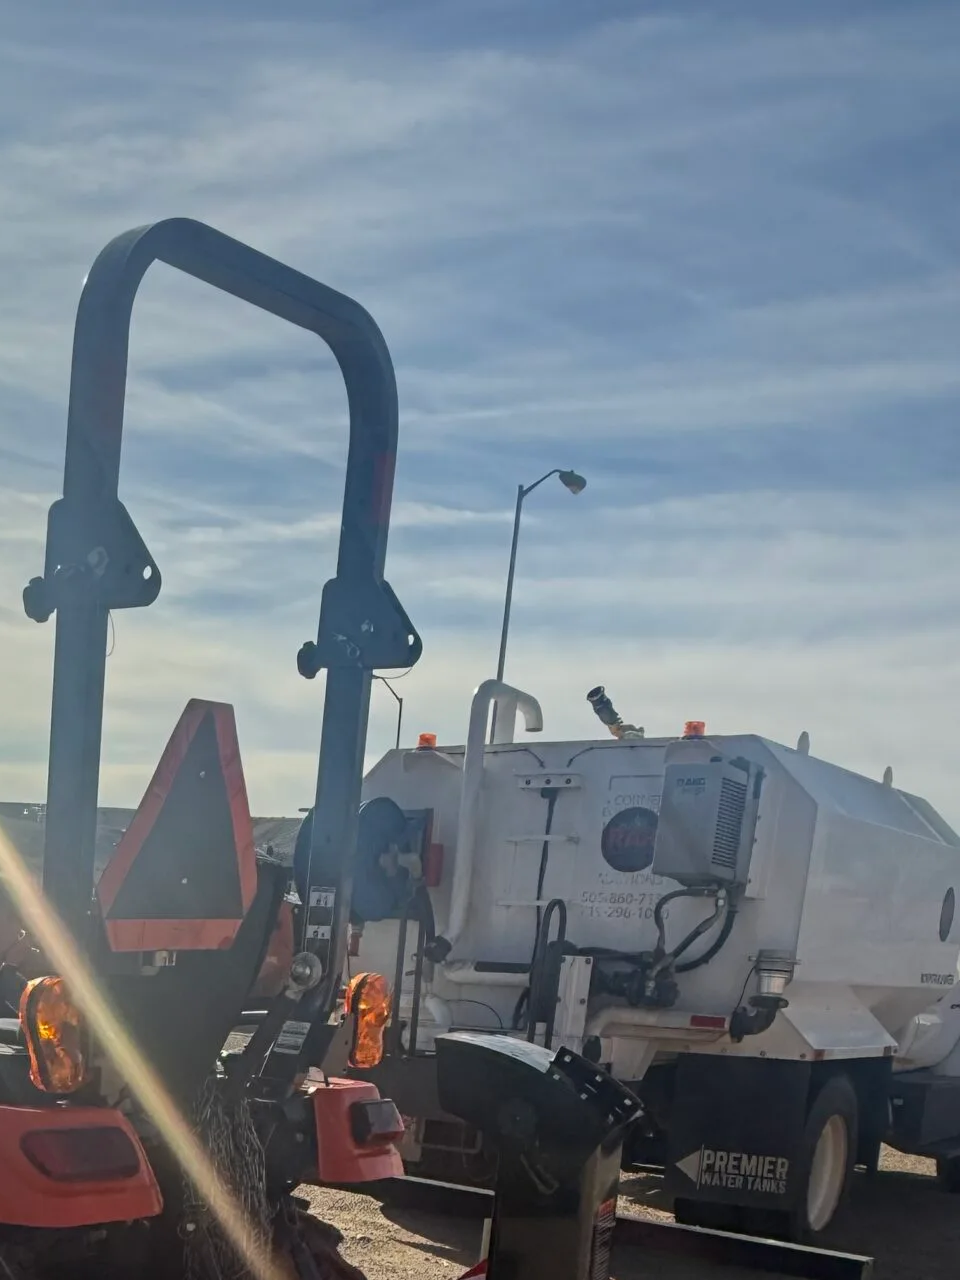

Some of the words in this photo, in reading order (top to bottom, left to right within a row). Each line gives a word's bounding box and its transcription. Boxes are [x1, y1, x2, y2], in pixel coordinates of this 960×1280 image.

[703, 1149, 790, 1181] PREMIER
[701, 1171, 744, 1190] WATER
[747, 1175, 787, 1194] TANKS
